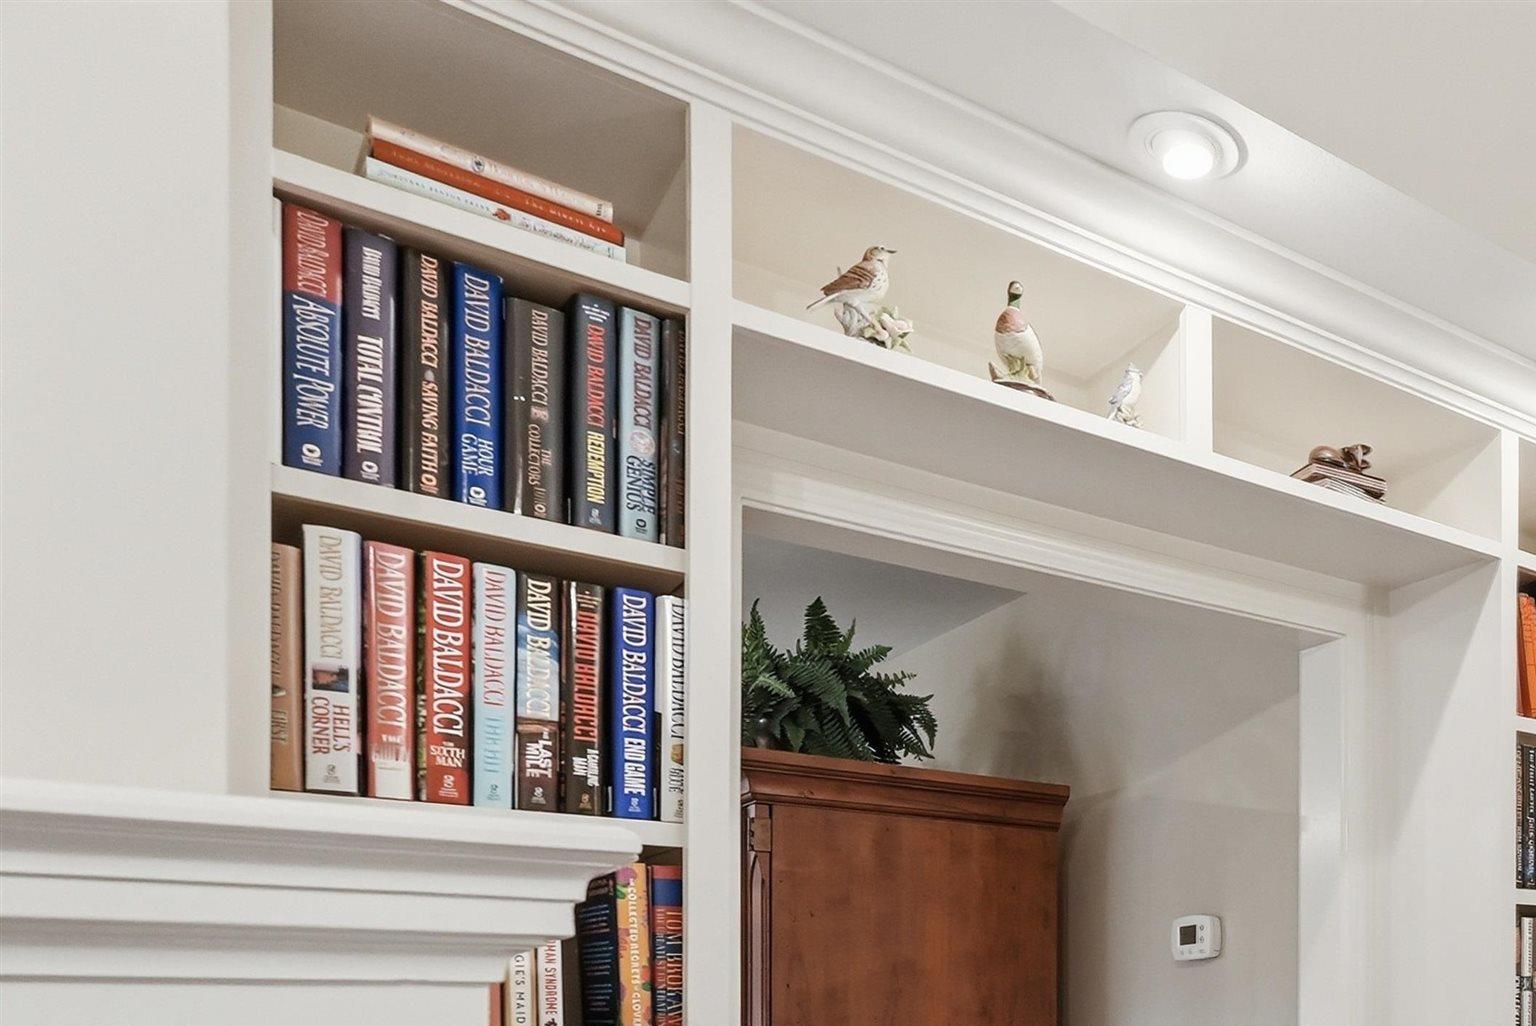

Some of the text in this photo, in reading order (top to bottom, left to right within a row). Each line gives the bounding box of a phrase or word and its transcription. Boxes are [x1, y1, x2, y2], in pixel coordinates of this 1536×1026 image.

[297, 211, 329, 297] DAVID BALDACCI
[421, 254, 438, 368] DAVID BALDACCI
[292, 295, 335, 430] ABSOLUTE POWER
[356, 335, 383, 382] TOTAL
[464, 273, 490, 427] DAVID BALDACCI
[531, 309, 548, 405] DAVID BALDACCI
[633, 316, 652, 430] DAVID BALDACCI
[422, 380, 438, 474] SAVING FAITH
[587, 324, 605, 504] DAVID BALDACCI REDEMPTION
[461, 433, 478, 475] GAME
[478, 439, 493, 476] HOUR
[528, 424, 542, 485] COLLECTORS
[626, 455, 642, 511] GENIUS
[642, 459, 657, 515] SIMPLE
[318, 535, 343, 659] DAVID BALDACCI
[376, 551, 406, 617] DAVID
[484, 570, 506, 621] DAVID
[377, 622, 407, 729] BALDACCI
[432, 559, 464, 737] DAVID BALDACCI
[483, 624, 506, 708] BALDACCI
[526, 578, 552, 718] DAVID BALDACCI
[573, 611, 597, 742] DAVID BALDACCI
[311, 696, 330, 754] CORNER
[332, 705, 351, 752] HELL'S
[622, 594, 647, 796] DAVID BALDACCI END GAME
[525, 742, 540, 778] MILE
[539, 739, 552, 778] LAST
[626, 887, 638, 942] COLLECTED
[543, 968, 558, 1015] SYNDROME
[629, 942, 641, 984] REGRETS
[666, 910, 682, 1026] TOM BROKAW
[515, 992, 527, 1024] MAID
